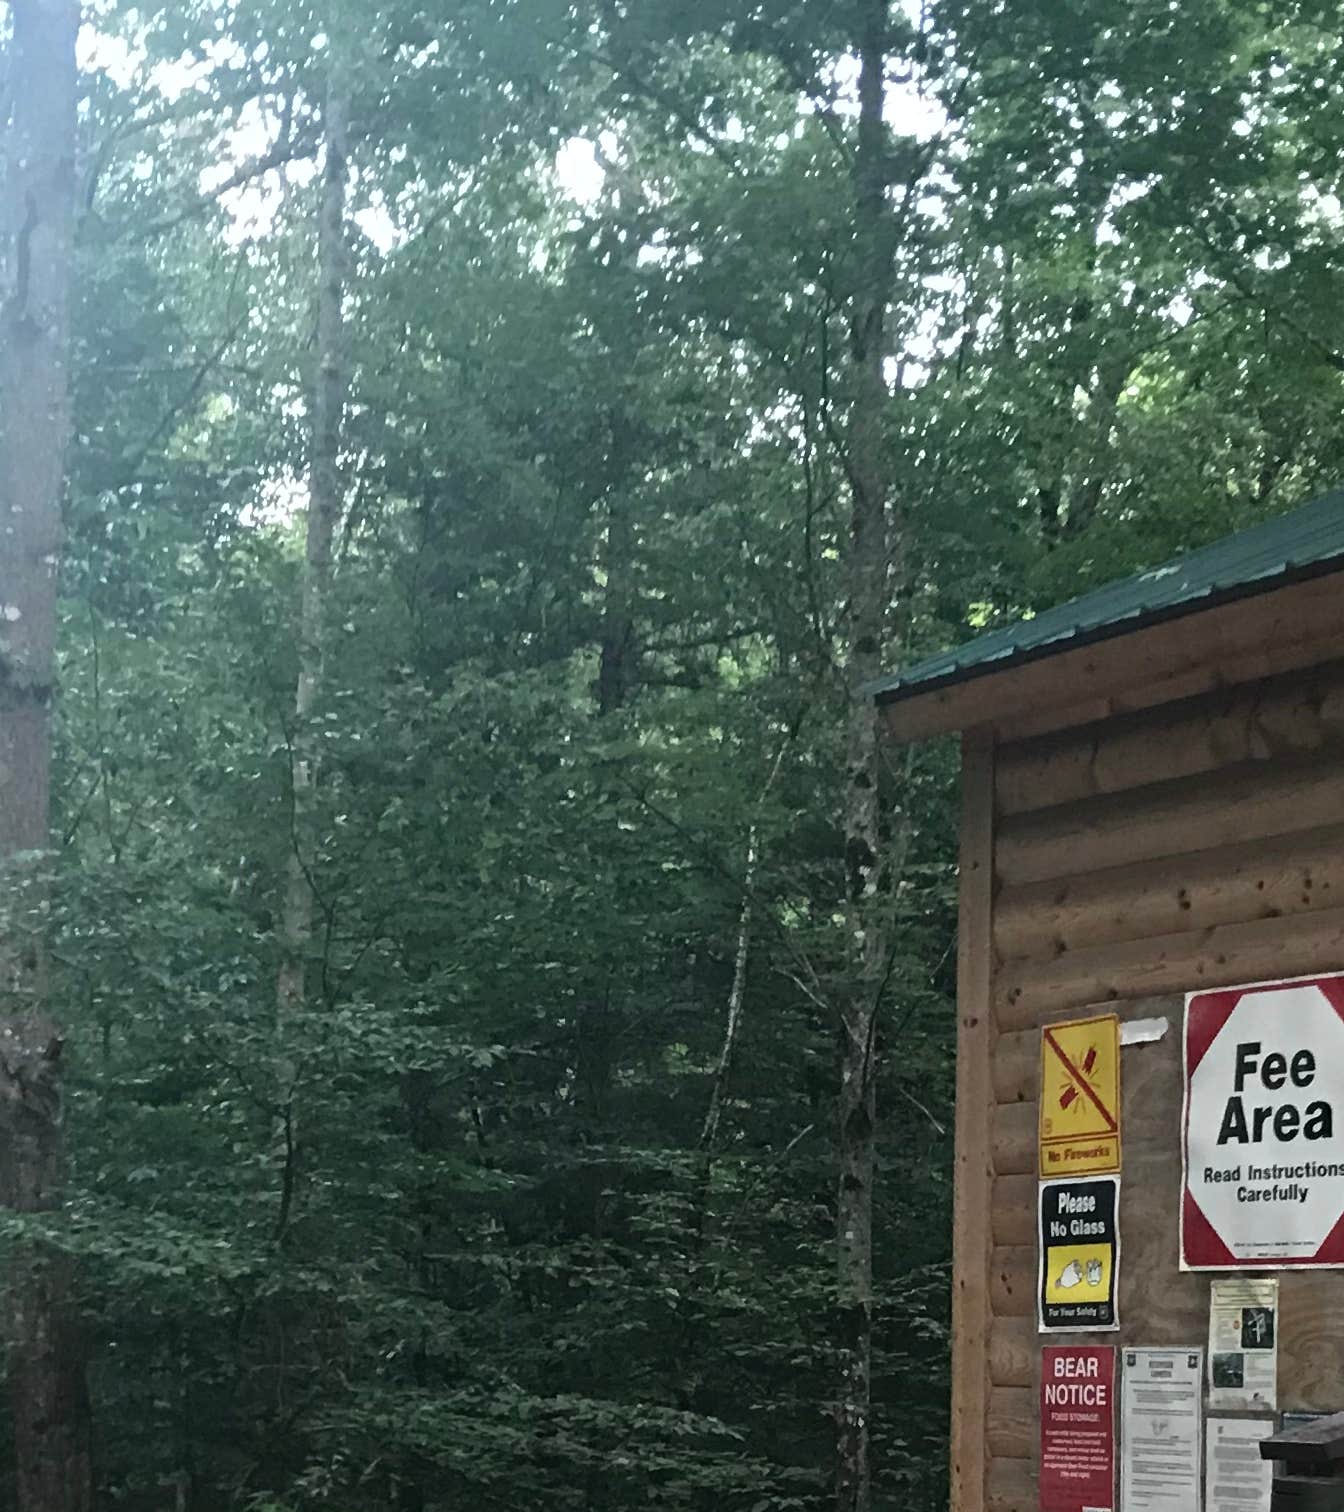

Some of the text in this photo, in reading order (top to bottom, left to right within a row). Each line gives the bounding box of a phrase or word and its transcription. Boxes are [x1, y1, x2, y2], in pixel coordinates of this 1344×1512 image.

[1234, 1042, 1317, 1092] Fee
[1216, 1096, 1334, 1145] Area
[1048, 1146, 1110, 1162] No Fireworks
[1204, 1165, 1241, 1183] Read
[1058, 1192, 1096, 1214] Please
[1237, 1184, 1309, 1203] Carefully
[1050, 1219, 1105, 1237] No Glass
[1048, 1305, 1097, 1317] For Your Safety
[1054, 1357, 1098, 1378] BEAR
[1045, 1384, 1106, 1406] NOTICE
